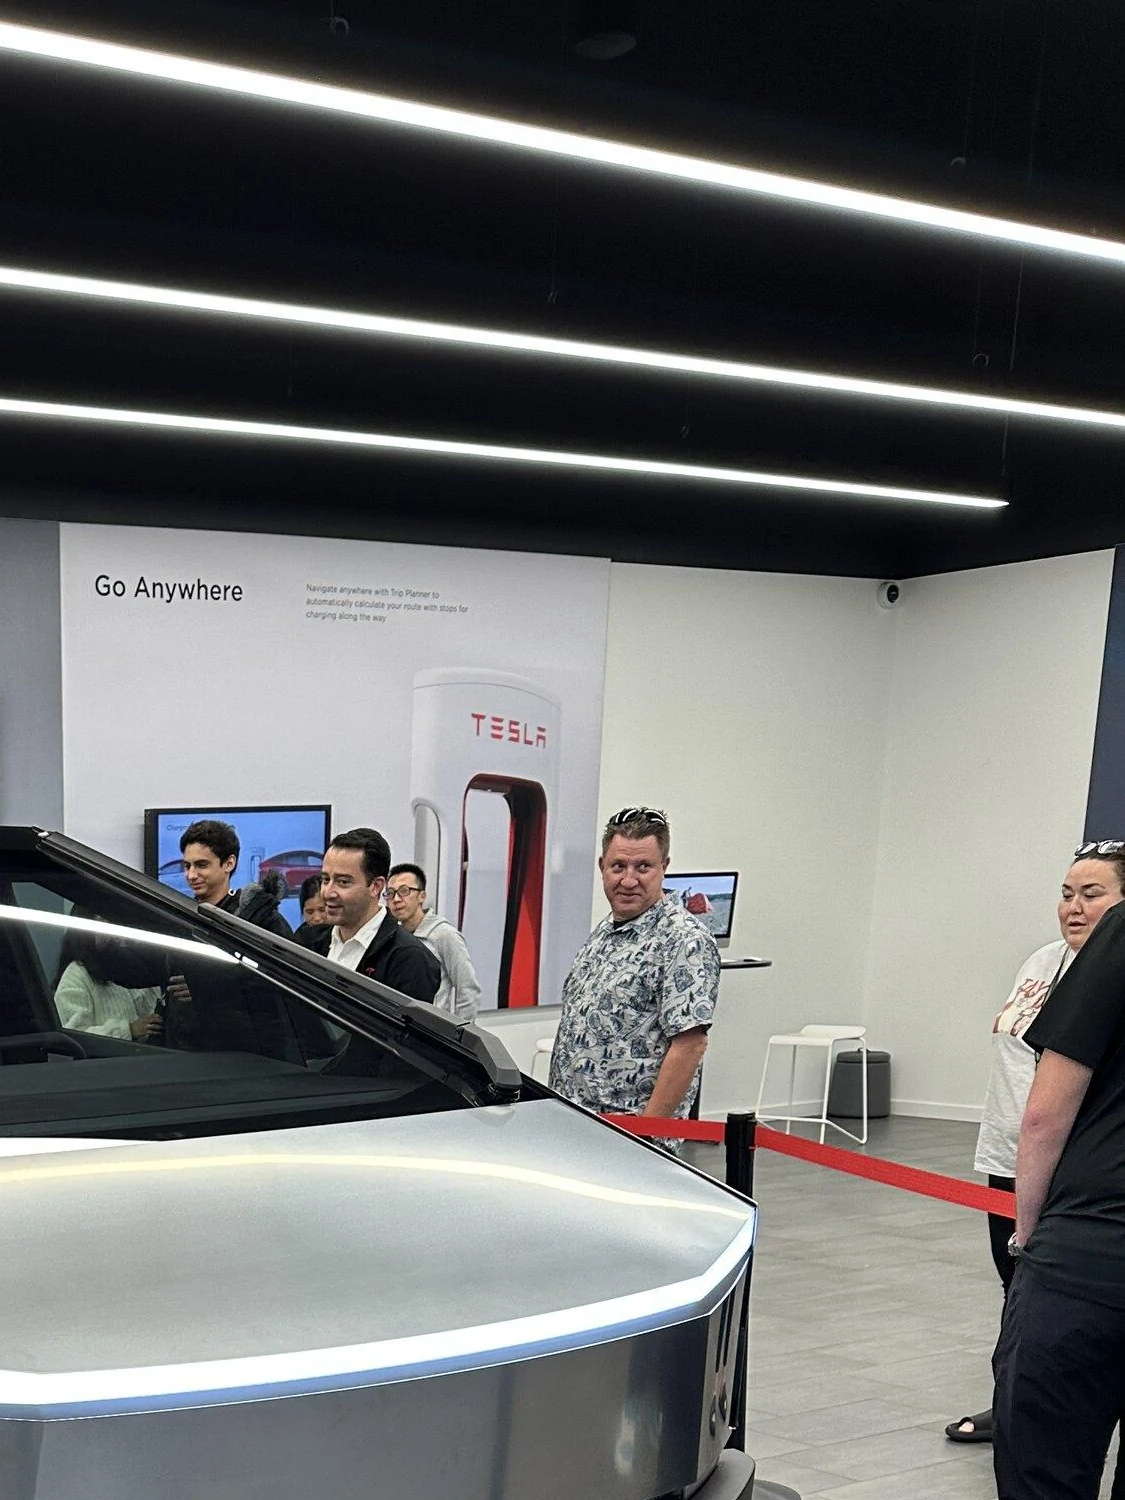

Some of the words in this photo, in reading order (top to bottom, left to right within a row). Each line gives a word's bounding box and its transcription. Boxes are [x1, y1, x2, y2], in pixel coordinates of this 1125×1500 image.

[95, 574, 125, 597] Go
[134, 576, 243, 603] Anywhere
[306, 584, 337, 594] Navigate
[340, 586, 372, 596] anywhere
[405, 589, 430, 598] Planner
[432, 591, 440, 599] to
[305, 598, 353, 608] automatically
[354, 600, 385, 609] calculate
[387, 603, 401, 611] your
[403, 603, 421, 611] route
[439, 605, 457, 613] stops
[458, 605, 468, 613] for
[305, 611, 337, 620] charging
[338, 612, 358, 621] along
[359, 613, 371, 621] the
[373, 615, 386, 623] way
[470, 712, 547, 750] TESLA
